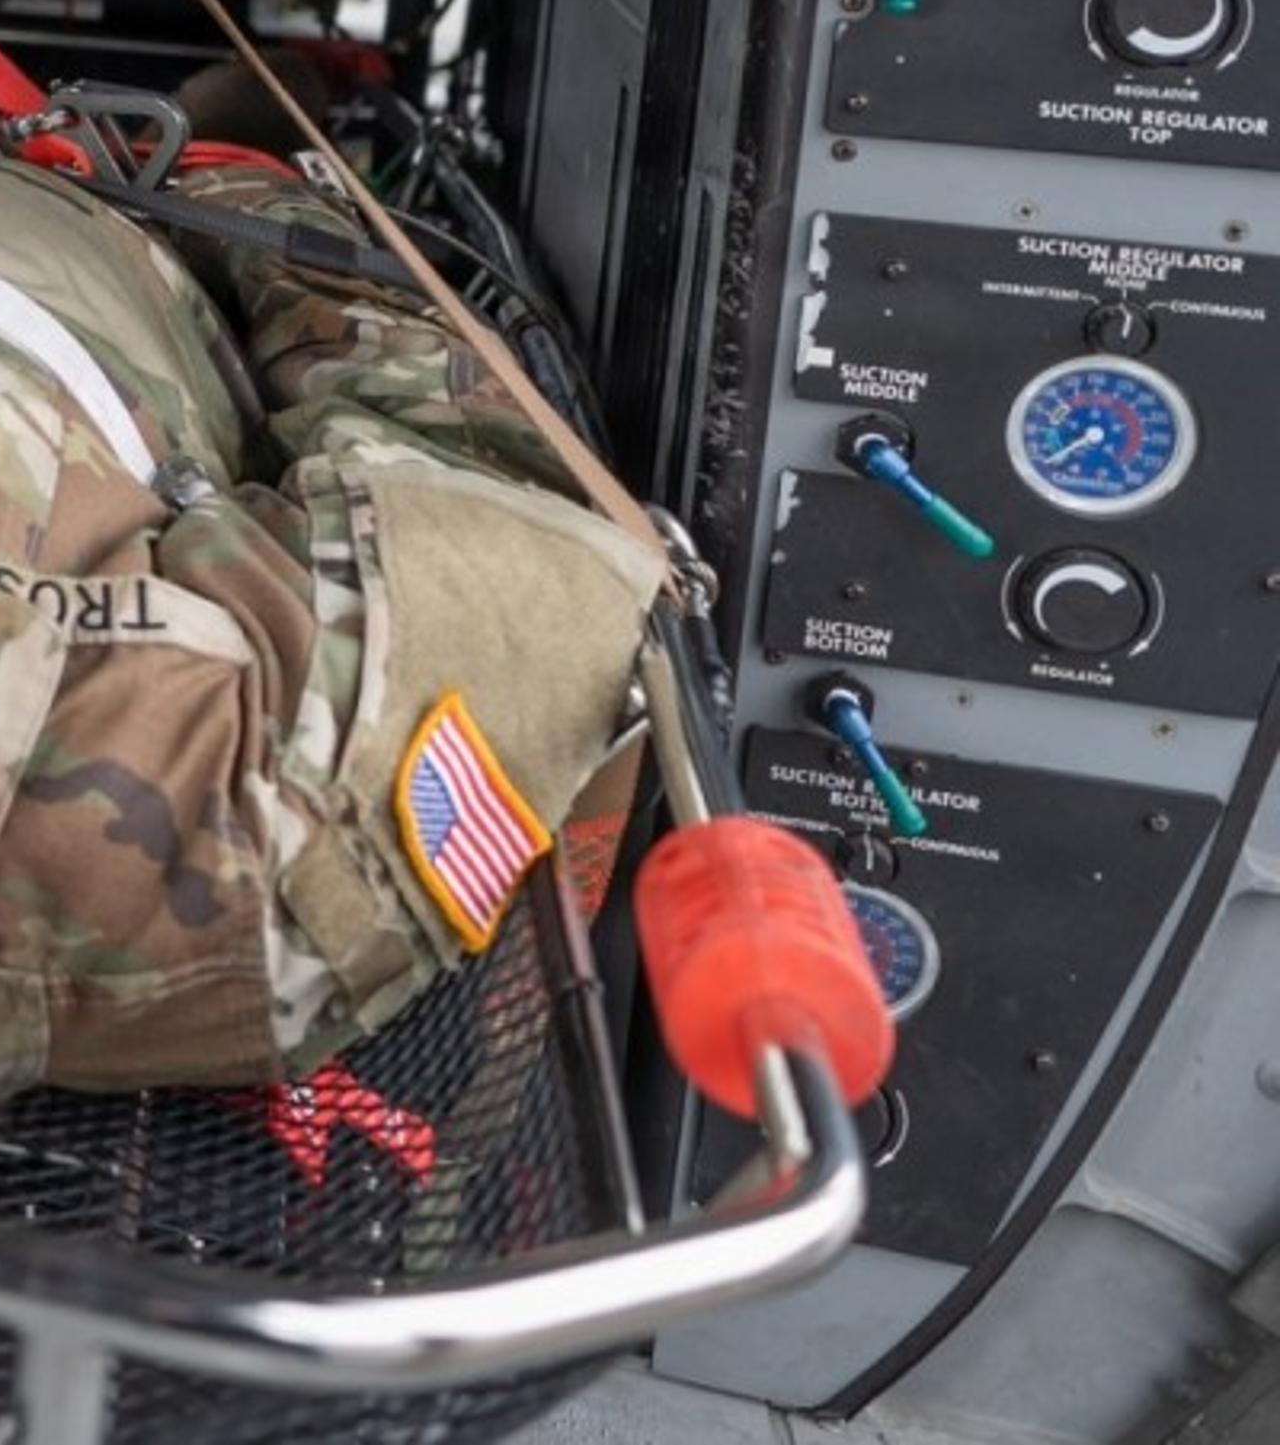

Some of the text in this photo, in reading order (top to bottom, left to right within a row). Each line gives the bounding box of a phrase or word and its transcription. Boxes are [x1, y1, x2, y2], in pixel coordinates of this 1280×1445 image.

[1114, 84, 1200, 102] REGULATOR
[1039, 100, 1268, 136] SUCTION REGULATOR
[1129, 126, 1172, 144] TOP
[1018, 236, 1244, 273] SUCTION REGULATOR
[1088, 260, 1168, 282] MIDDLE
[1170, 299, 1267, 321] CONTINUOUS
[840, 363, 929, 388] SUCTION
[844, 380, 919, 403] MIDDLE
[805, 618, 894, 644] SUCTION
[803, 634, 888, 660] BOTTOM
[1031, 663, 1115, 687] REGULATOR
[769, 765, 981, 812] SUCTION RLATOR
[830, 791, 890, 813] BOTT
